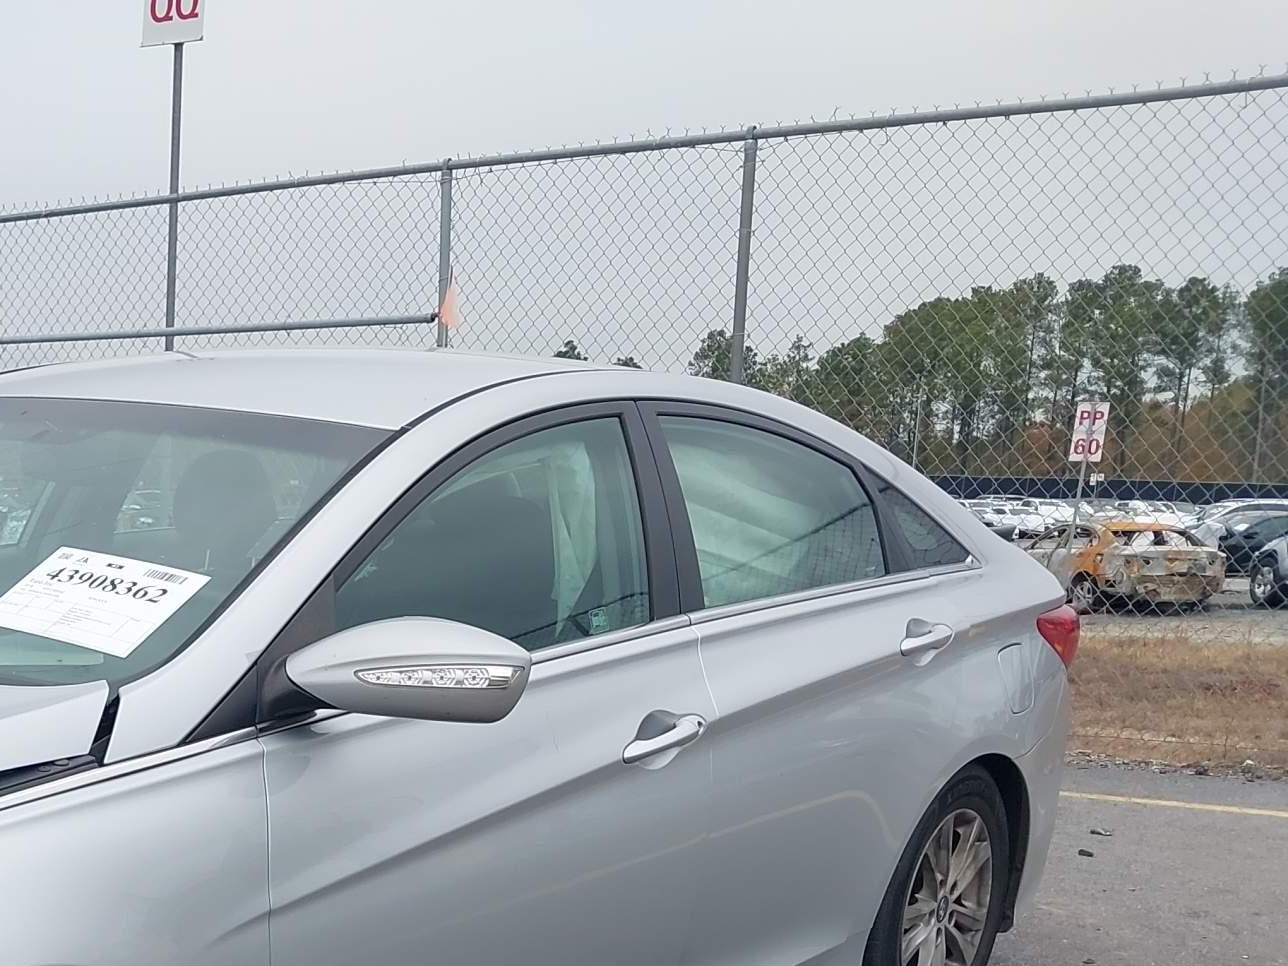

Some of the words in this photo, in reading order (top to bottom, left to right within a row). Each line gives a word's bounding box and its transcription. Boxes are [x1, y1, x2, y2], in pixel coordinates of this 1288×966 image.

[1079, 410, 1105, 426] PP
[1073, 438, 1101, 455] 60
[45, 567, 169, 604] 43908362
